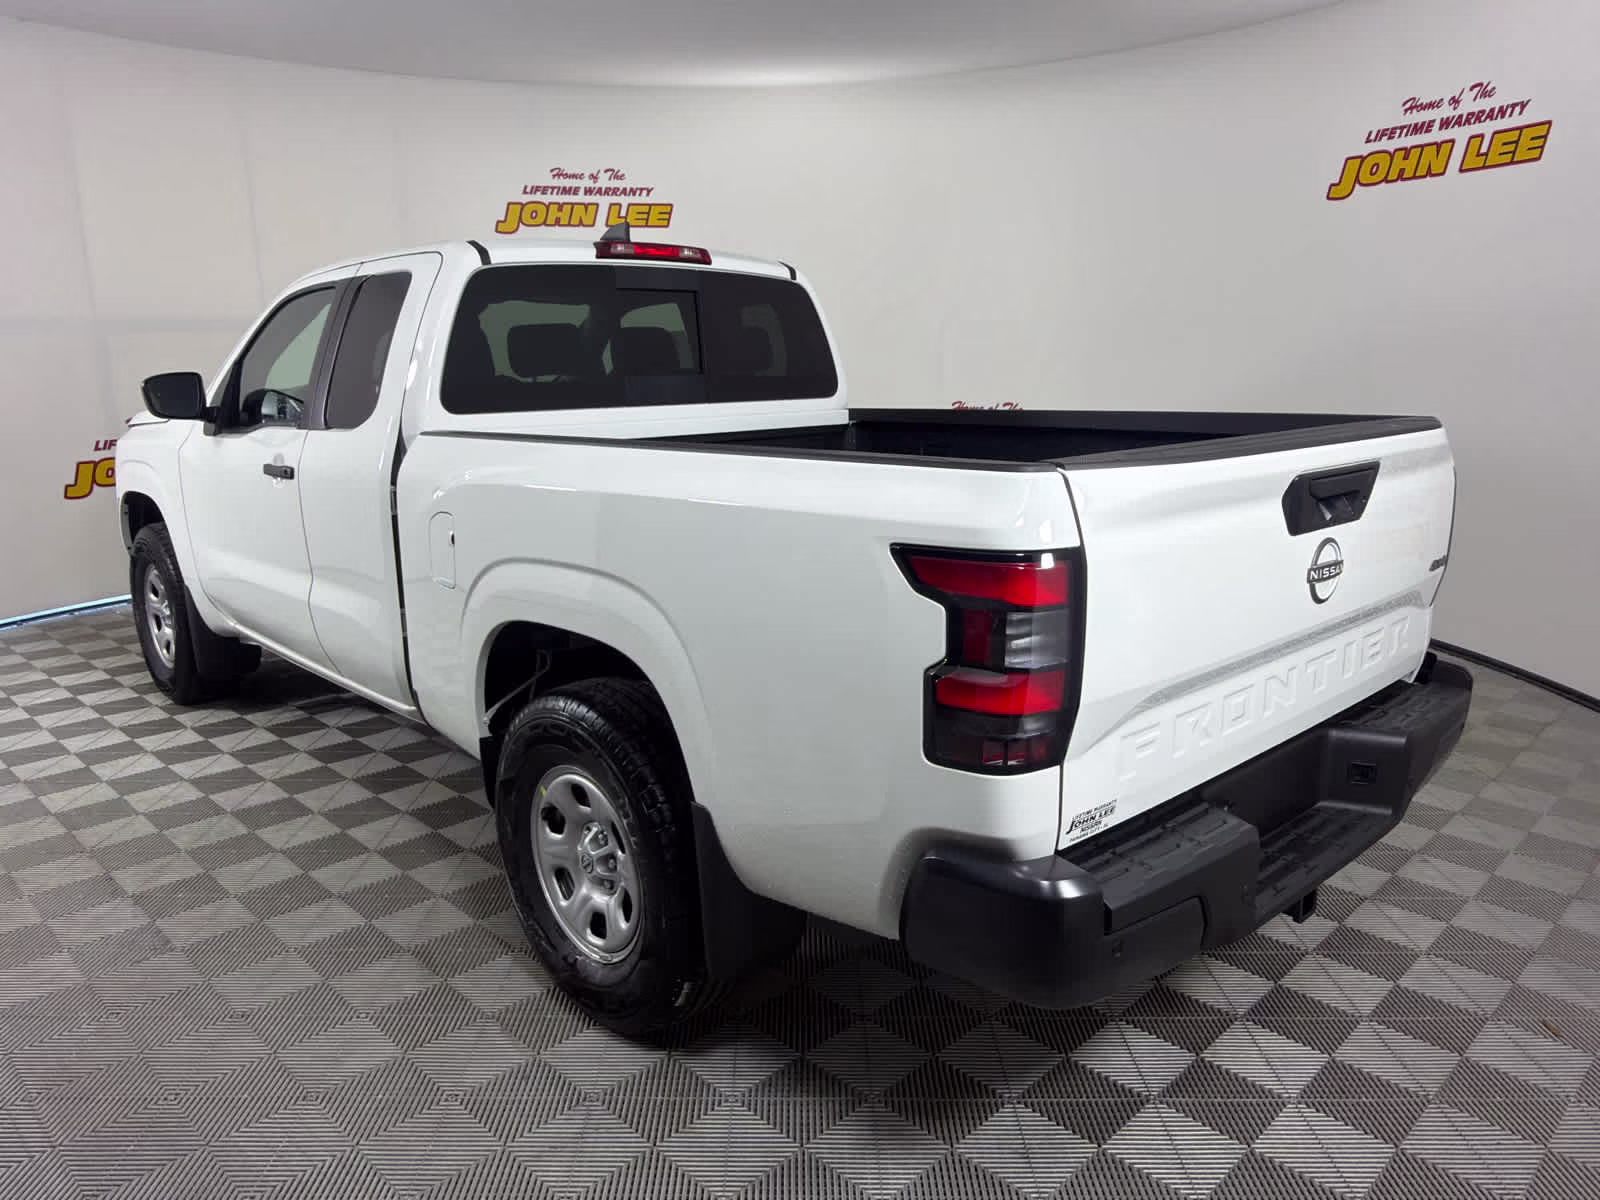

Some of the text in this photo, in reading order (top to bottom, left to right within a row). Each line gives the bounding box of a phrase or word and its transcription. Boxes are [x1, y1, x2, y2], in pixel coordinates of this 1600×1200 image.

[1401, 80, 1496, 116] Home of The
[1364, 99, 1532, 144] LIFETIME WARRANTY
[549, 167, 626, 184] Home of The
[1326, 120, 1552, 200] JOHN LEE
[522, 185, 655, 197] LIFETIME WARRANTY
[495, 201, 673, 234] JOHN LEE
[64, 457, 116, 499] JO
[1309, 561, 1344, 580] NISSAN
[1115, 615, 1411, 782] FRONTIER
[1065, 815, 1097, 835] JOHN
